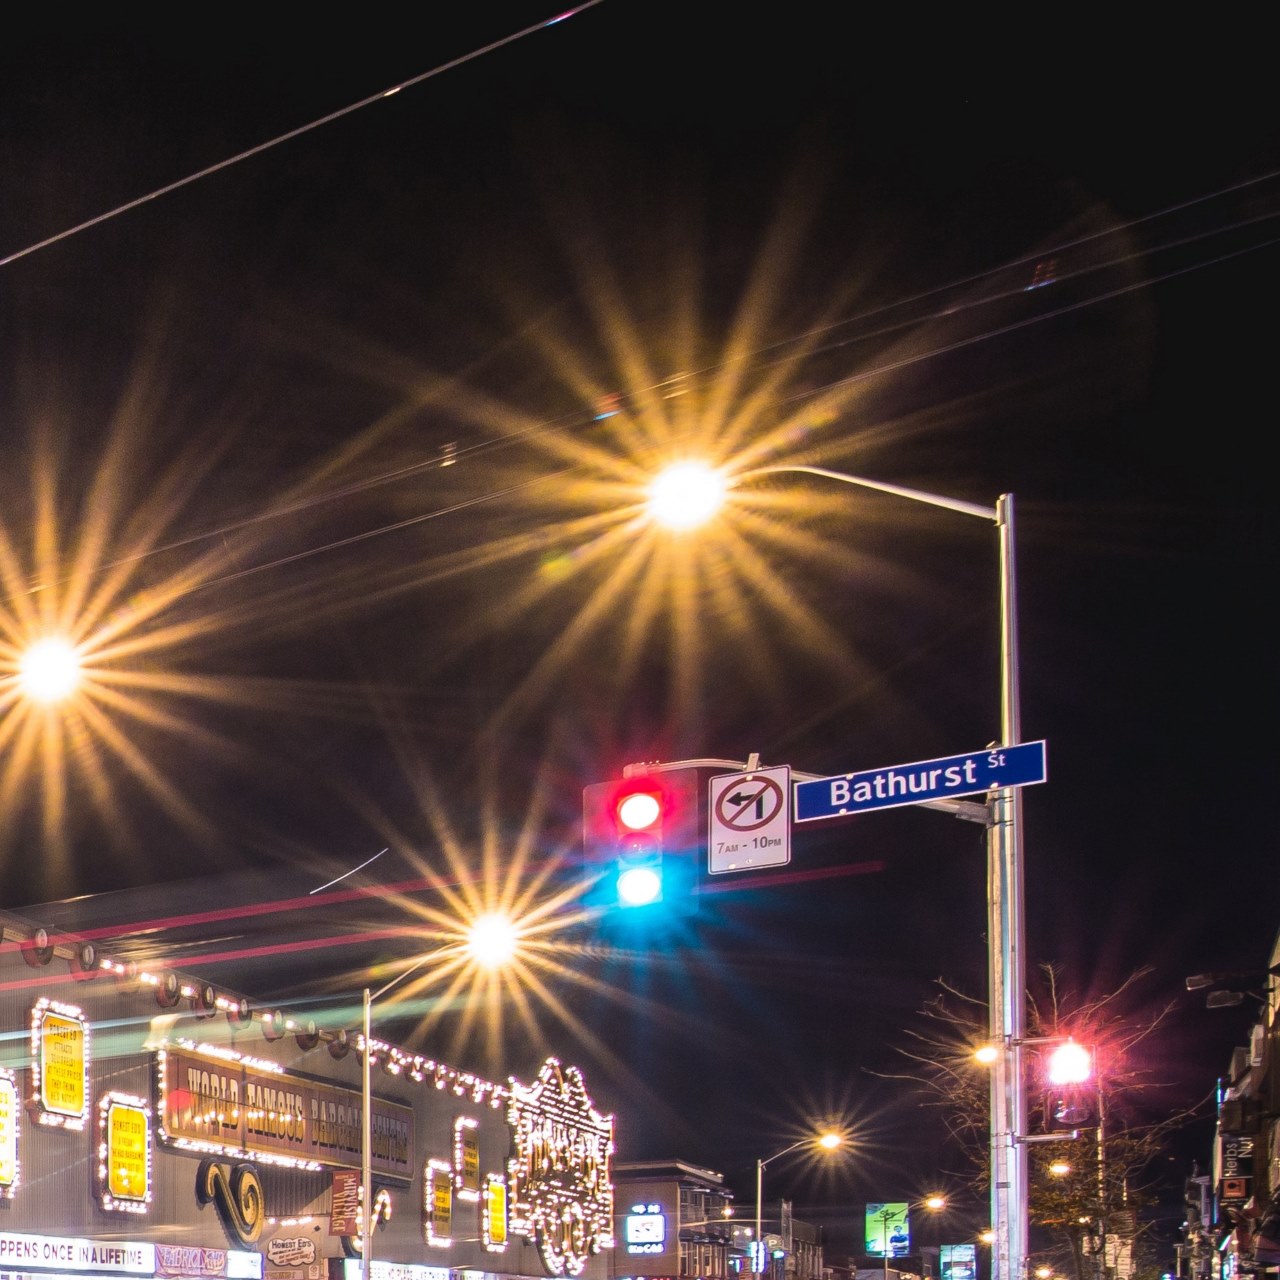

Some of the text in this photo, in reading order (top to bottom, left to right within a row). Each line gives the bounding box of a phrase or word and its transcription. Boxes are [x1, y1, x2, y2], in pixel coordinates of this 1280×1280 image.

[831, 754, 1005, 806] Bathurst St
[717, 842, 738, 854] 7AM
[752, 836, 782, 850] 10PM
[188, 1067, 239, 1130] WORLD
[247, 1083, 304, 1144] FAMOUS
[113, 1120, 130, 1133] HONEST
[1224, 1143, 1238, 1177] Herbs
[333, 1191, 346, 1232] VILLAGE
[344, 1177, 358, 1219] MIRVISH
[43, 1242, 74, 1261] ONCE
[78, 1246, 89, 1262] IN
[91, 1247, 98, 1263] A
[99, 1248, 142, 1265] LIFETIME
